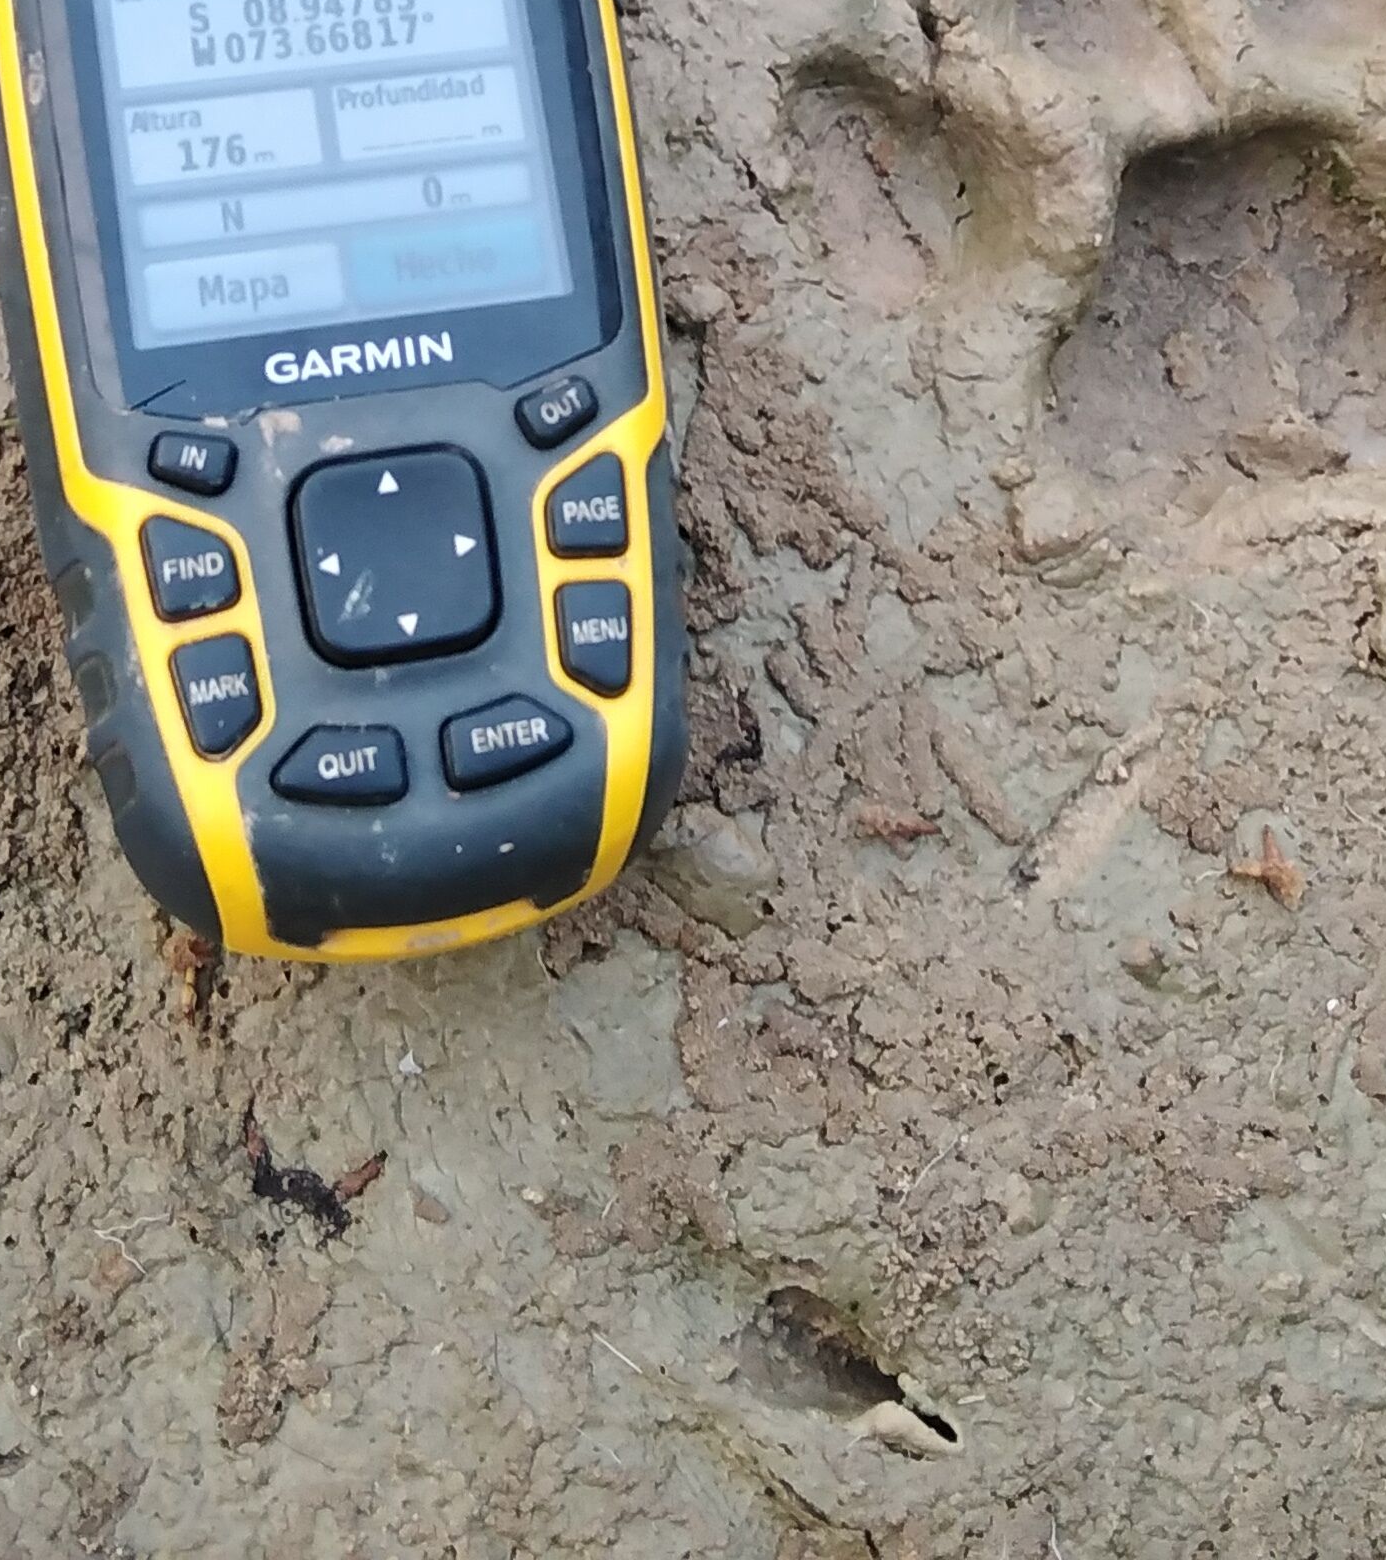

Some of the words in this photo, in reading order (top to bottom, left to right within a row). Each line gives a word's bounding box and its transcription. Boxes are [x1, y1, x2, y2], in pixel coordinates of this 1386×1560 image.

[189, 2, 211, 34] S
[191, 34, 216, 67] W
[337, 73, 485, 112] Profundidad
[129, 107, 202, 134] Altura
[178, 133, 249, 172] 176
[421, 176, 444, 208] 0
[220, 200, 245, 232] N
[198, 271, 290, 312] Mapa
[264, 331, 454, 384] GARMIN
[540, 388, 583, 425] OUT
[179, 444, 208, 470] IN
[561, 494, 622, 524] PAGE
[162, 551, 225, 583] FIND
[571, 614, 629, 645] MENU
[188, 673, 249, 707] MARK
[470, 716, 550, 753] ENTER
[317, 746, 380, 781] QUIT
